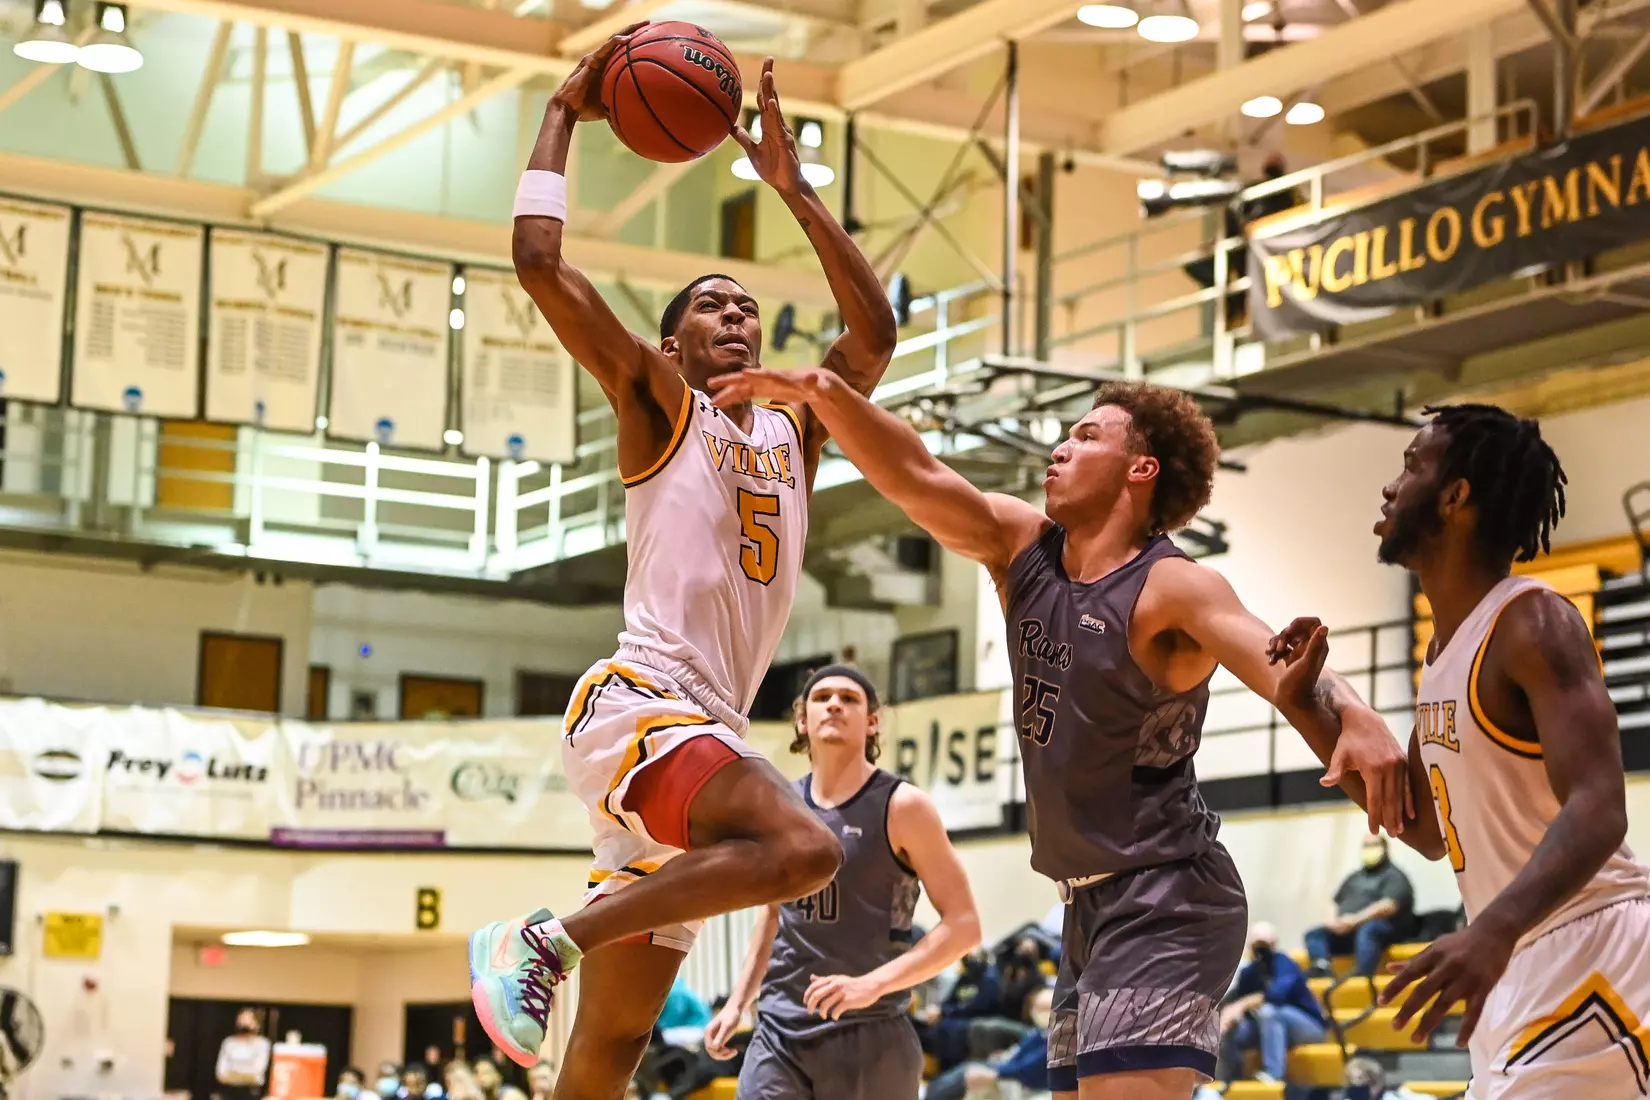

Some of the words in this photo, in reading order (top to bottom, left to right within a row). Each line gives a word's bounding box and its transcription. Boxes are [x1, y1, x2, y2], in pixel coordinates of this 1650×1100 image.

[1263, 207, 1462, 309] PUCILLO
[1471, 146, 1650, 248] GYMNA
[702, 431, 795, 489] VILLE
[737, 487, 780, 586] 5
[1018, 618, 1074, 671] Ravns
[1022, 674, 1061, 747] 25
[106, 750, 172, 780] Frey
[298, 740, 406, 773] UPMC
[896, 717, 997, 789] RISE
[295, 778, 431, 811] Pinnacle
[416, 887, 440, 930] B
[796, 878, 840, 924] 40
